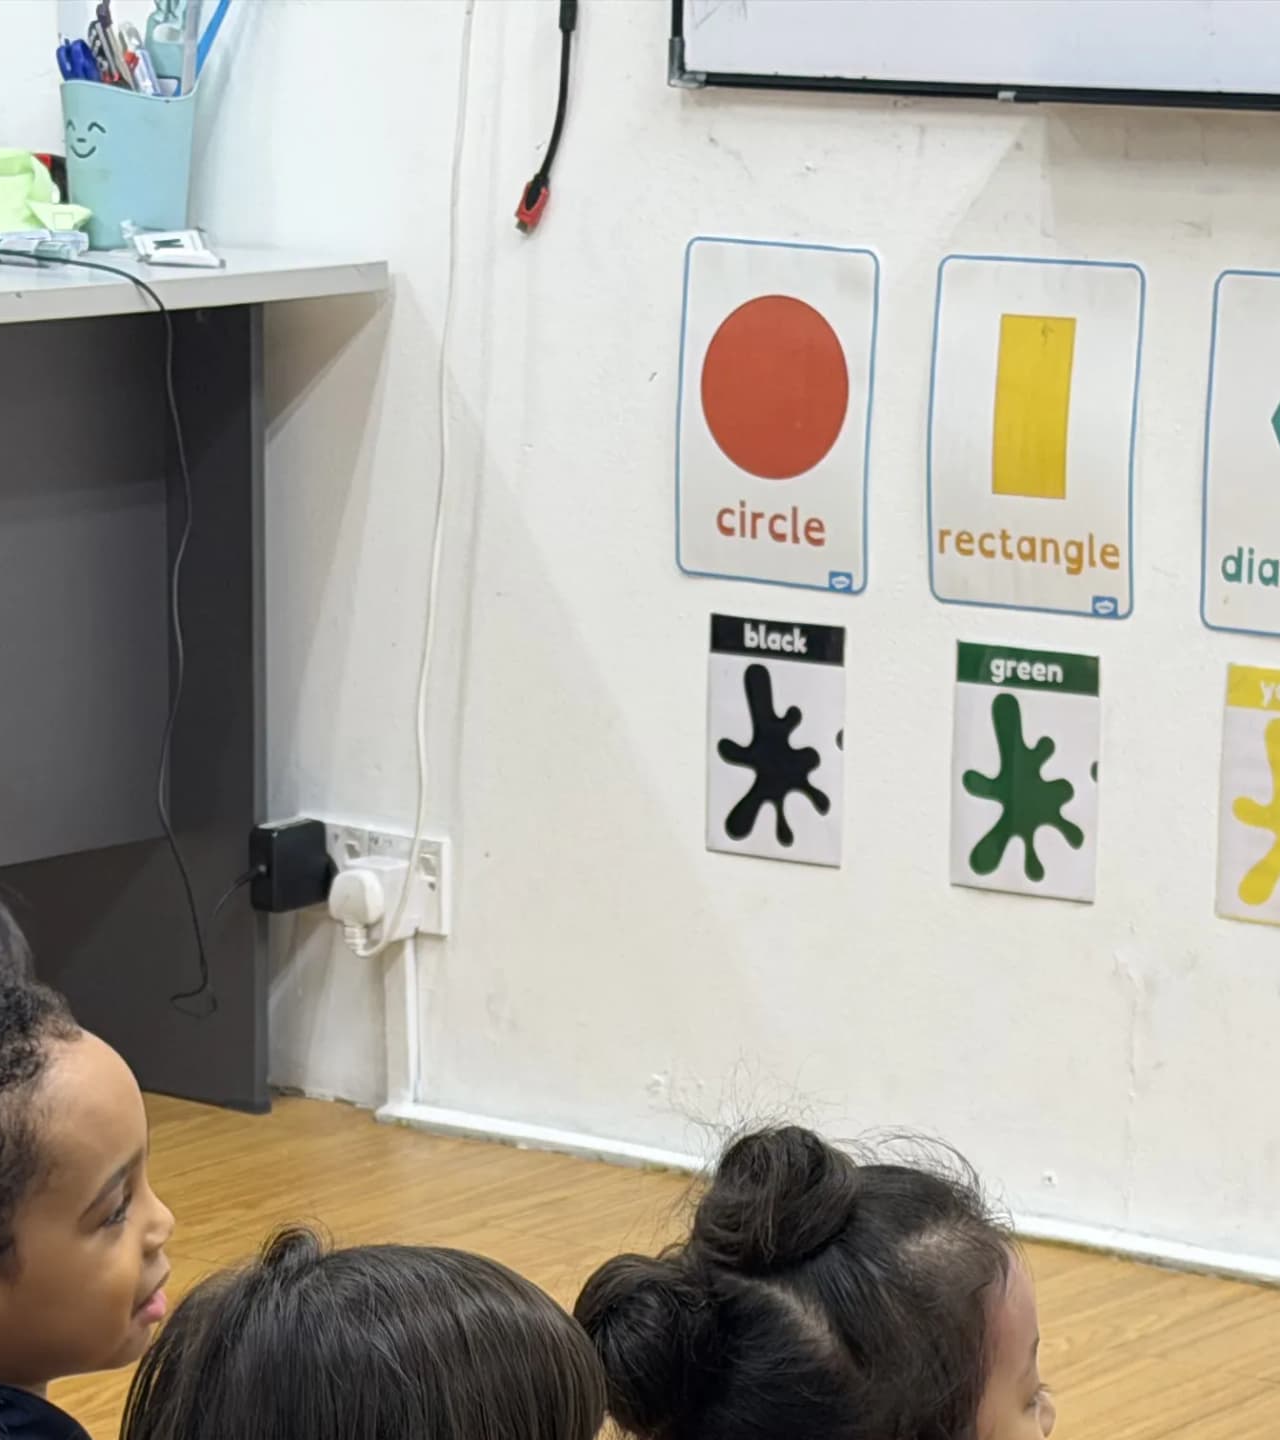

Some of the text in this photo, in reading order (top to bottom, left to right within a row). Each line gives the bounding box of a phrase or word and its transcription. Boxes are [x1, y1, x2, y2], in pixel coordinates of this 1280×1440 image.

[716, 500, 826, 547] circle
[938, 528, 1121, 576] rectangle
[743, 622, 808, 654] black
[989, 657, 1063, 686] green
